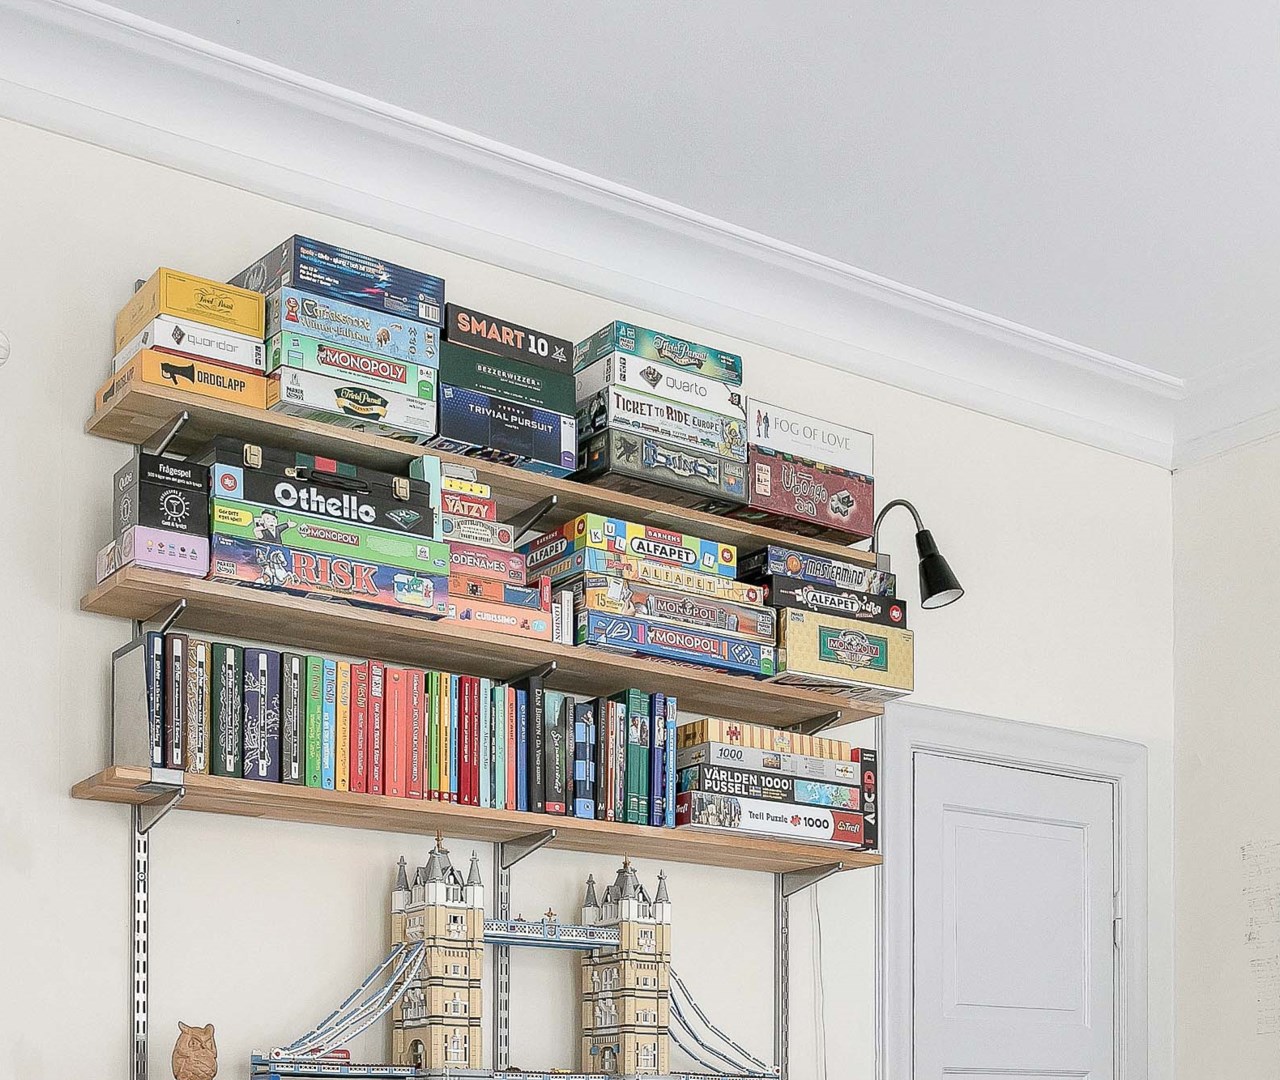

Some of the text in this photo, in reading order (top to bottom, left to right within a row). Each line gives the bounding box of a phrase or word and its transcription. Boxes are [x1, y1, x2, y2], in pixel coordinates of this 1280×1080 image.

[187, 334, 239, 352] quoridor
[457, 312, 549, 357] SMART 10
[326, 350, 404, 379] MONOPOLY
[197, 370, 246, 392] ORDGLAPP
[478, 365, 536, 385] BEZZERWIZZER
[666, 377, 707, 397] Quarto
[468, 403, 554, 433] TRIVIAL PURSUIT
[614, 392, 720, 432] TICKET TO RIDE EUROPE
[775, 418, 799, 435] FOG
[803, 426, 818, 440] OF
[822, 431, 850, 450] LOVE
[159, 464, 191, 477] Frågespel
[782, 464, 828, 503] Ubongo
[274, 482, 376, 523] Othello
[445, 498, 488, 518] YATZY
[311, 529, 357, 544] MONOPOLY
[647, 530, 680, 543] BARNENS
[528, 541, 565, 566] ALFAPET
[637, 541, 691, 561] ALFAPET
[292, 552, 379, 595] RISK
[642, 567, 713, 591] ALFAPET
[806, 559, 864, 585] MASTERMIND
[595, 593, 606, 606] 15
[811, 594, 855, 610] ALFAPET
[656, 632, 717, 652] MONOPOL
[373, 666, 382, 675] JO
[536, 739, 540, 748] DA
[719, 747, 743, 760] 1000
[704, 767, 757, 785] VÄRLDEN
[705, 779, 748, 795] PUSSEL
[766, 812, 788, 823] Puzzle
[804, 817, 829, 829] 1000
[845, 822, 860, 833] Trefl
